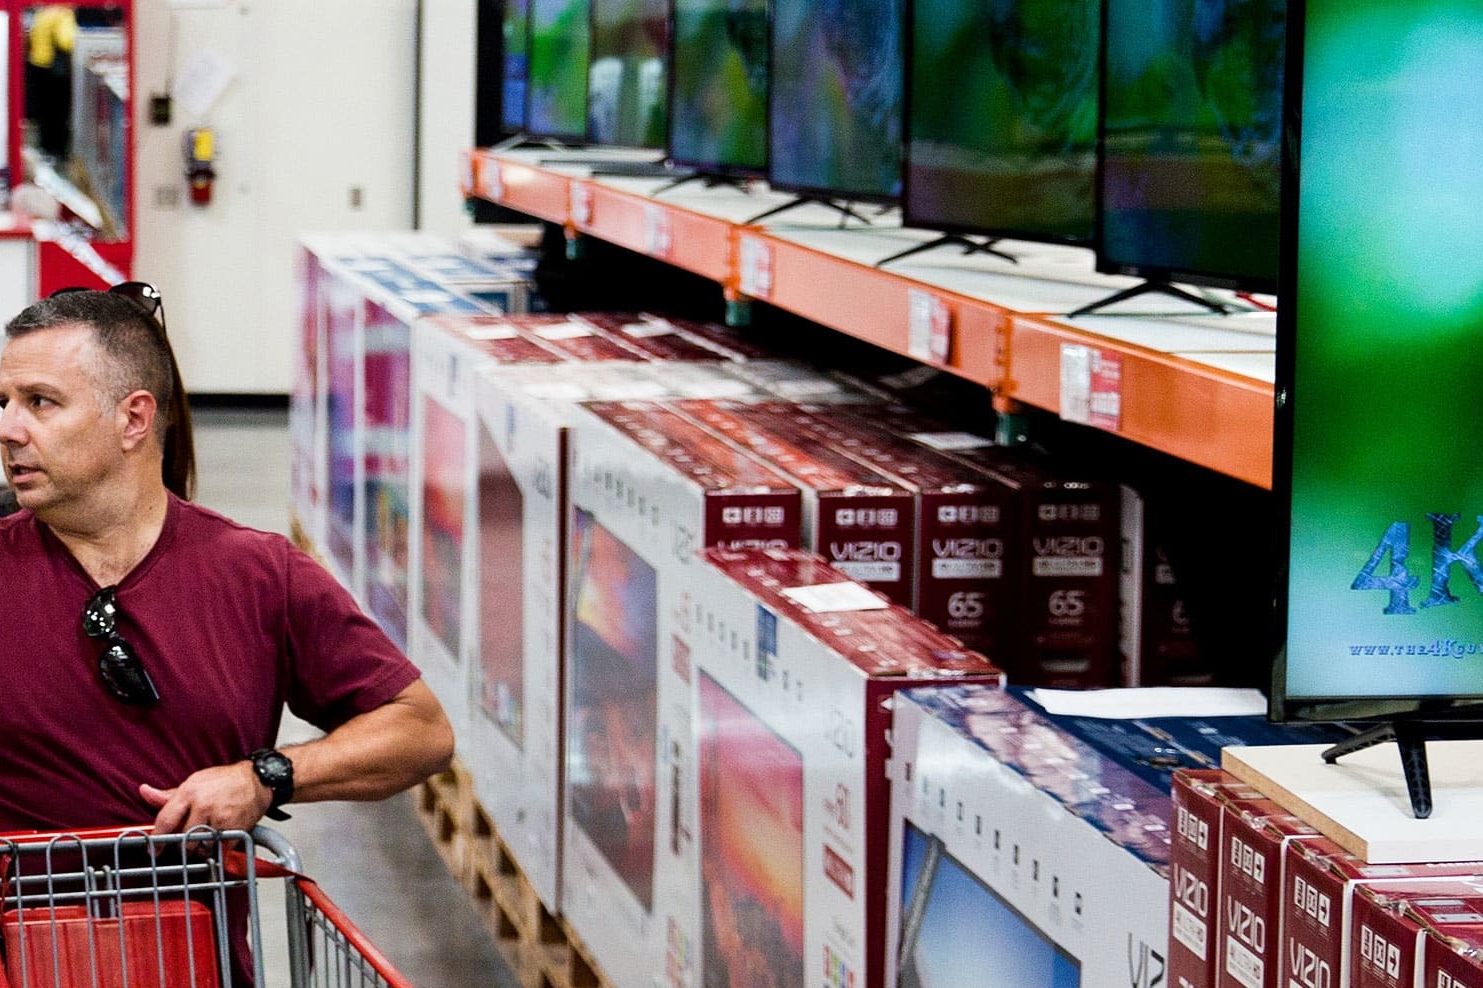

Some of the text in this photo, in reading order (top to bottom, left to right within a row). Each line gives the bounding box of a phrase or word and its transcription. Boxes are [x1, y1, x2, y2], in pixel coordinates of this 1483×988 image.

[830, 541, 901, 561] VIZIO
[932, 538, 1003, 558] VIZIO
[1033, 536, 1104, 556] VIZIO
[1350, 513, 1483, 616] 4K
[948, 591, 985, 618] 65
[1048, 590, 1085, 616] 65
[1173, 862, 1208, 918] VIZIO
[1227, 895, 1265, 954] VIZIO
